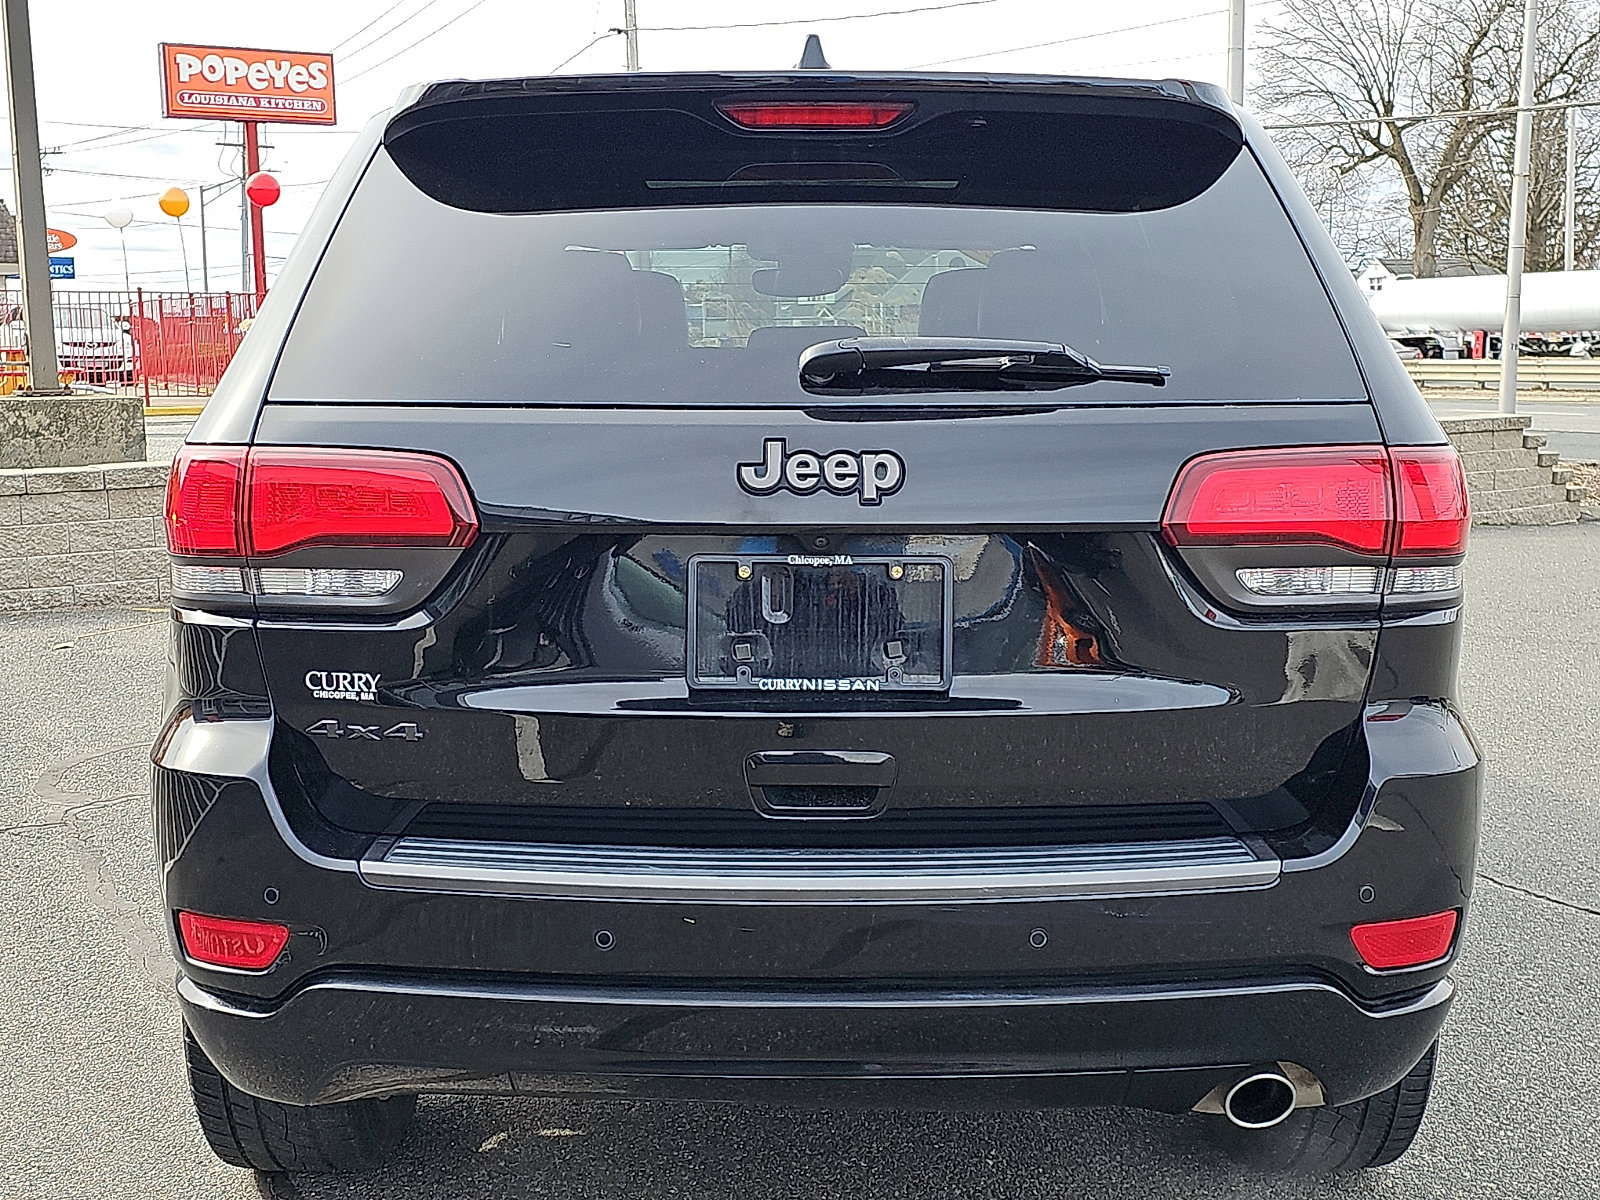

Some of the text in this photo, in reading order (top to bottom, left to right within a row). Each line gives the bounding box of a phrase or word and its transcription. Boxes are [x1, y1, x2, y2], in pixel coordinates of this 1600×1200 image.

[182, 92, 323, 111] LOUISIANA KITCHEN
[740, 440, 901, 501] Jeep
[834, 555, 853, 565] MA
[305, 670, 381, 692] CURRY
[758, 678, 880, 691] CURRY NISSAN
[313, 690, 375, 701] CHICOPEE, MA
[305, 719, 424, 742] 4x4
